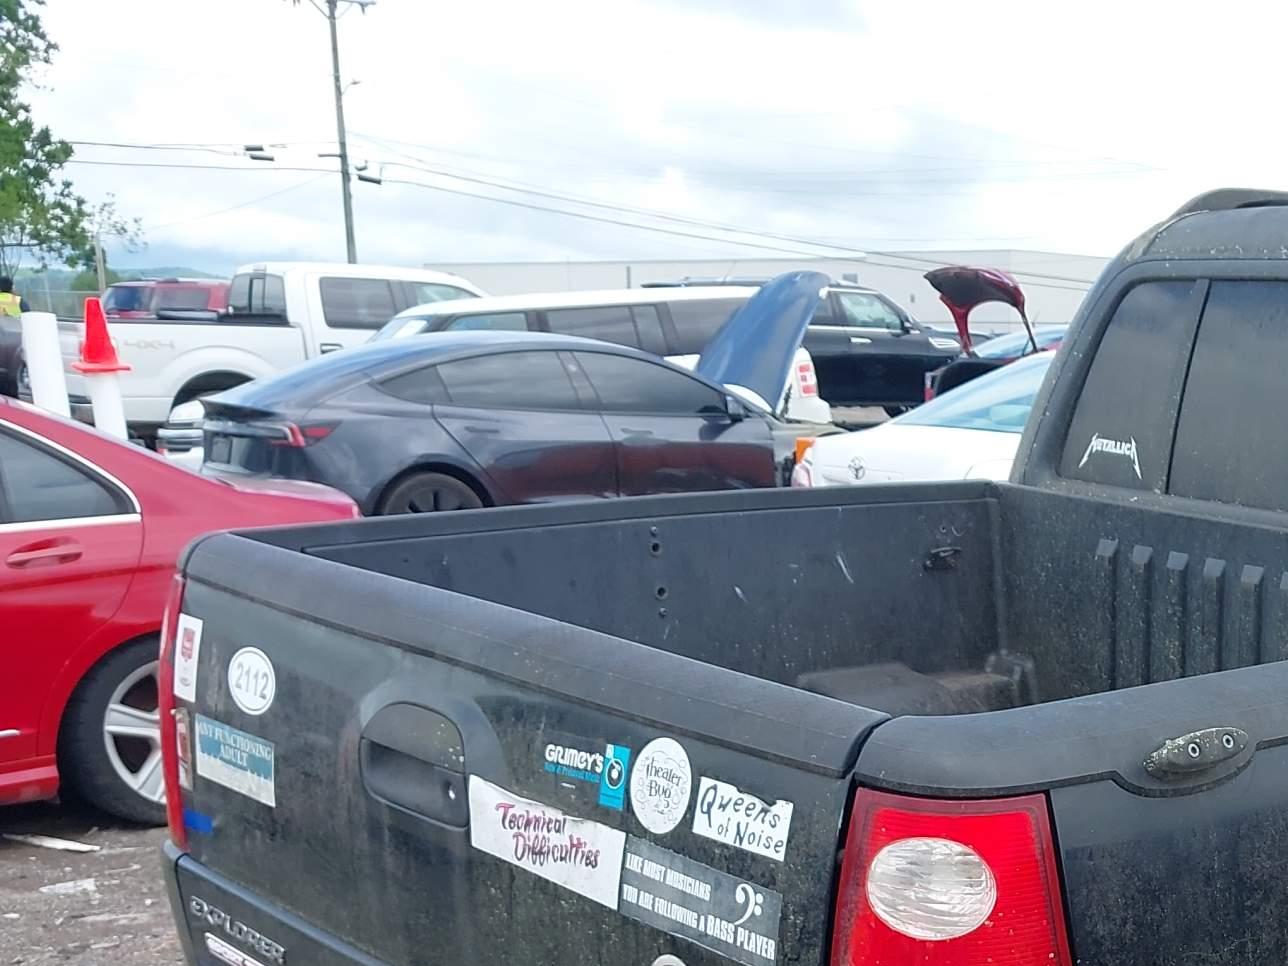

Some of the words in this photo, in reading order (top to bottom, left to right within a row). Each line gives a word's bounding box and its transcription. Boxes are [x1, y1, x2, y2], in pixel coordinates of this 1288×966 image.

[1079, 432, 1142, 480] METALLICA
[235, 661, 269, 700] 2112
[494, 802, 567, 835] Technical
[701, 784, 781, 829] Queens
[512, 831, 600, 869] Difficulties
[717, 817, 731, 837] of
[733, 821, 784, 854] Noise
[625, 852, 644, 873] LIKE
[643, 860, 665, 883] MOST
[665, 868, 712, 901] MUSICIANS
[190, 895, 285, 965] EXPLORER
[622, 883, 639, 904] YOU
[639, 890, 654, 911] ARE
[654, 897, 699, 929] FOLLOWING
[698, 915, 705, 933] A
[706, 914, 735, 944] BASS
[736, 926, 776, 961] PLAYER
